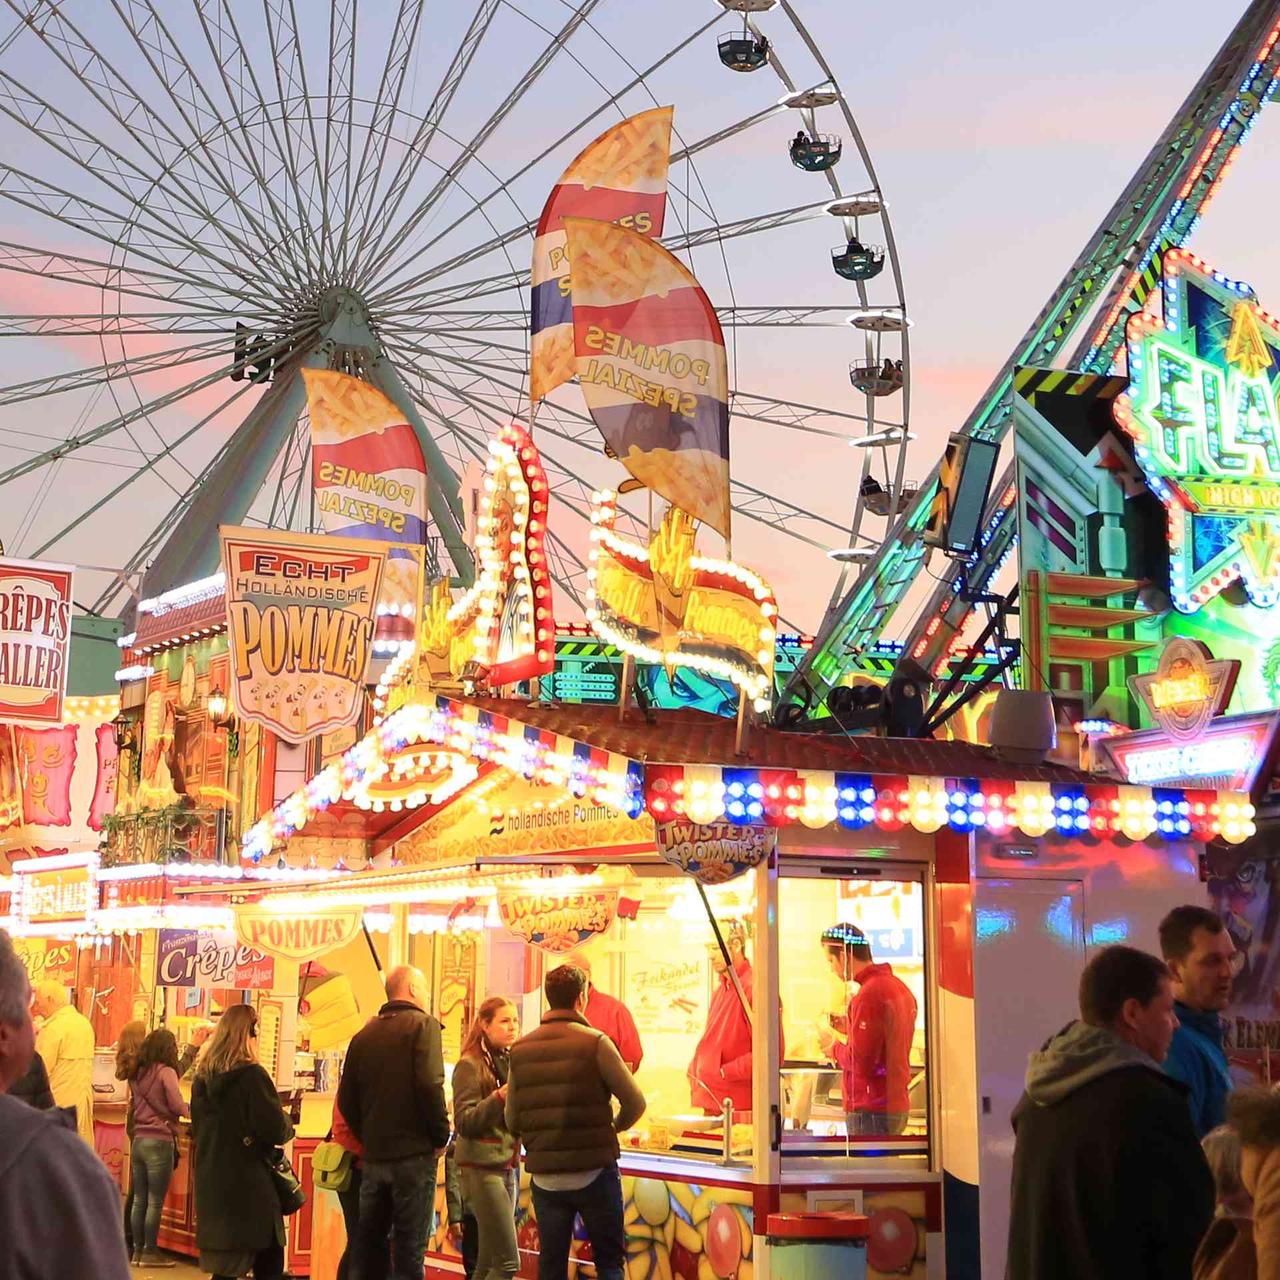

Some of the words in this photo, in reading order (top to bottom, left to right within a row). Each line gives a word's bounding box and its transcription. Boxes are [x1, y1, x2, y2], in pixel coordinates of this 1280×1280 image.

[1205, 486, 1256, 508] HIGH
[255, 554, 354, 584] ECHT
[236, 577, 369, 604] HOLLÄNDISCHE
[685, 590, 758, 652] Pommes
[229, 600, 375, 682] POMMES
[680, 839, 764, 869] POMMES
[250, 918, 345, 950] POMMES
